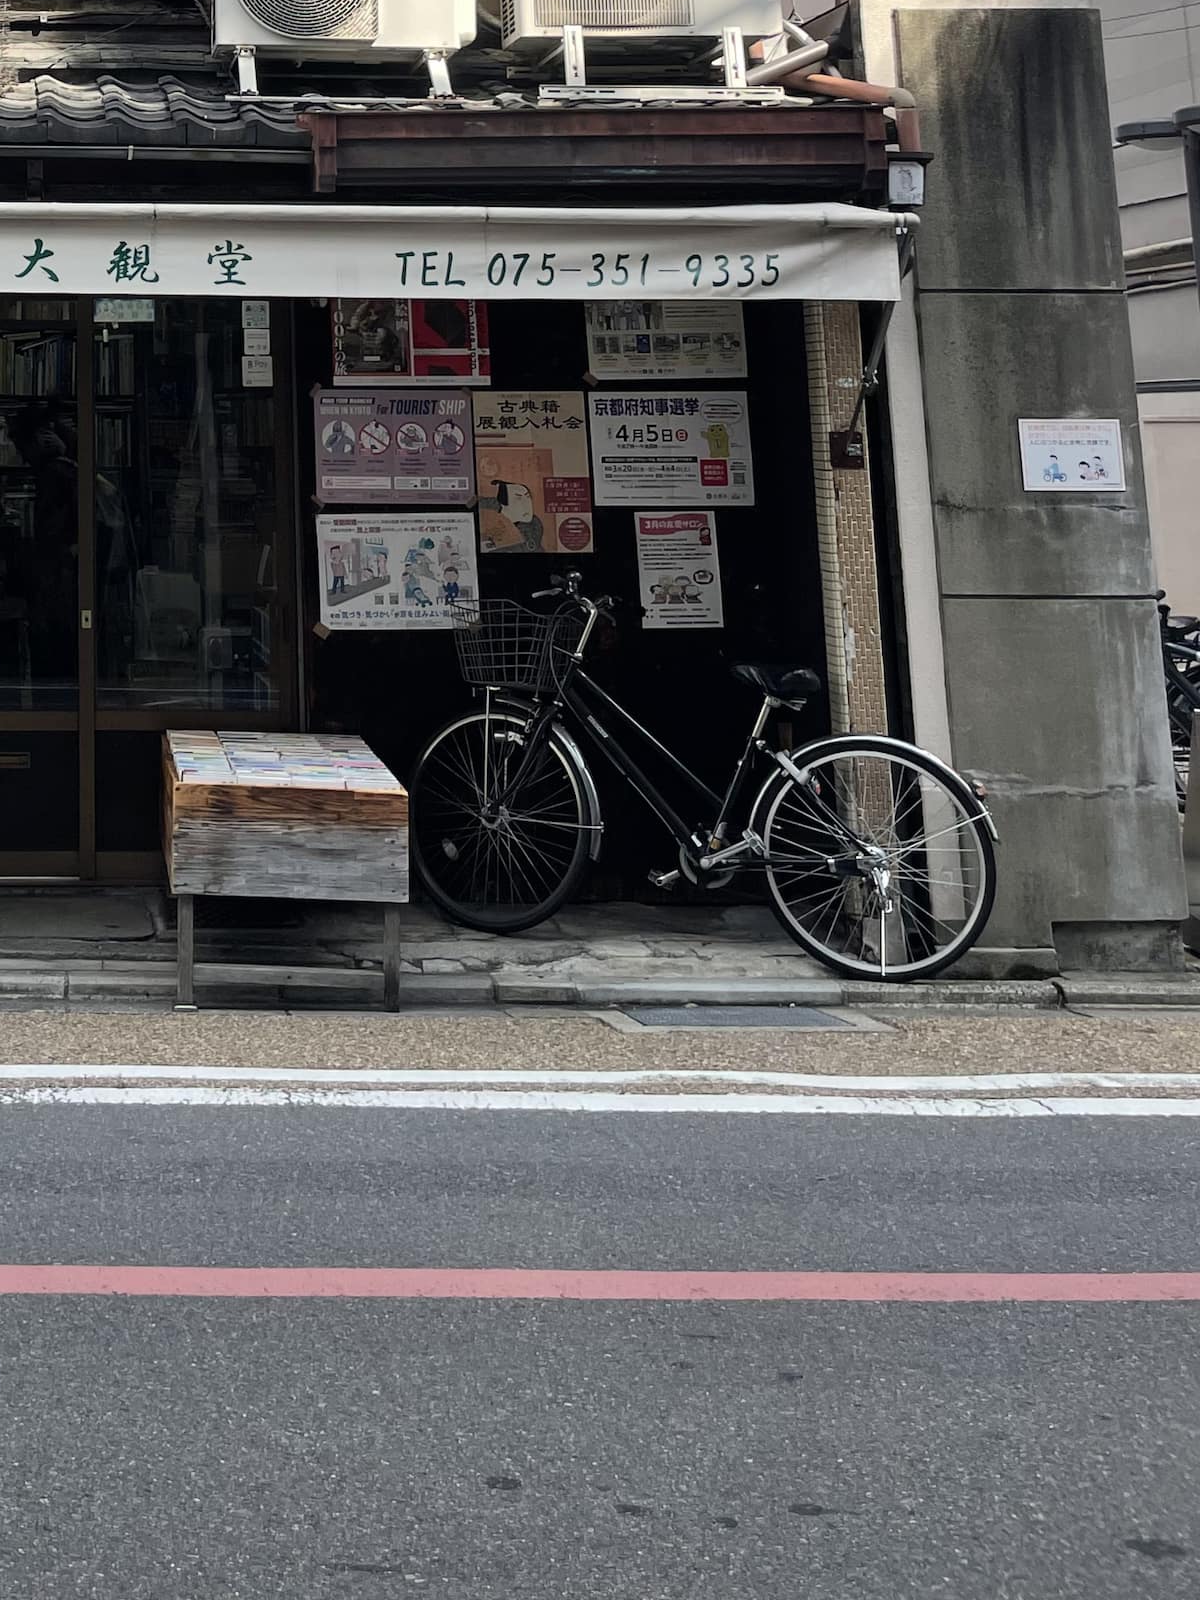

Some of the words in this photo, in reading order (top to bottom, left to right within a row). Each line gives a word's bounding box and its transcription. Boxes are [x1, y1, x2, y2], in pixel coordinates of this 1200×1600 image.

[395, 251, 466, 287] TEL
[487, 251, 780, 287] 075-351-9335
[389, 399, 438, 415] TOURIST
[438, 399, 466, 415] SHIP
[497, 400, 561, 414] 古典籍
[594, 398, 700, 416] 京都府知事選挙
[476, 415, 584, 430] 展観入札会
